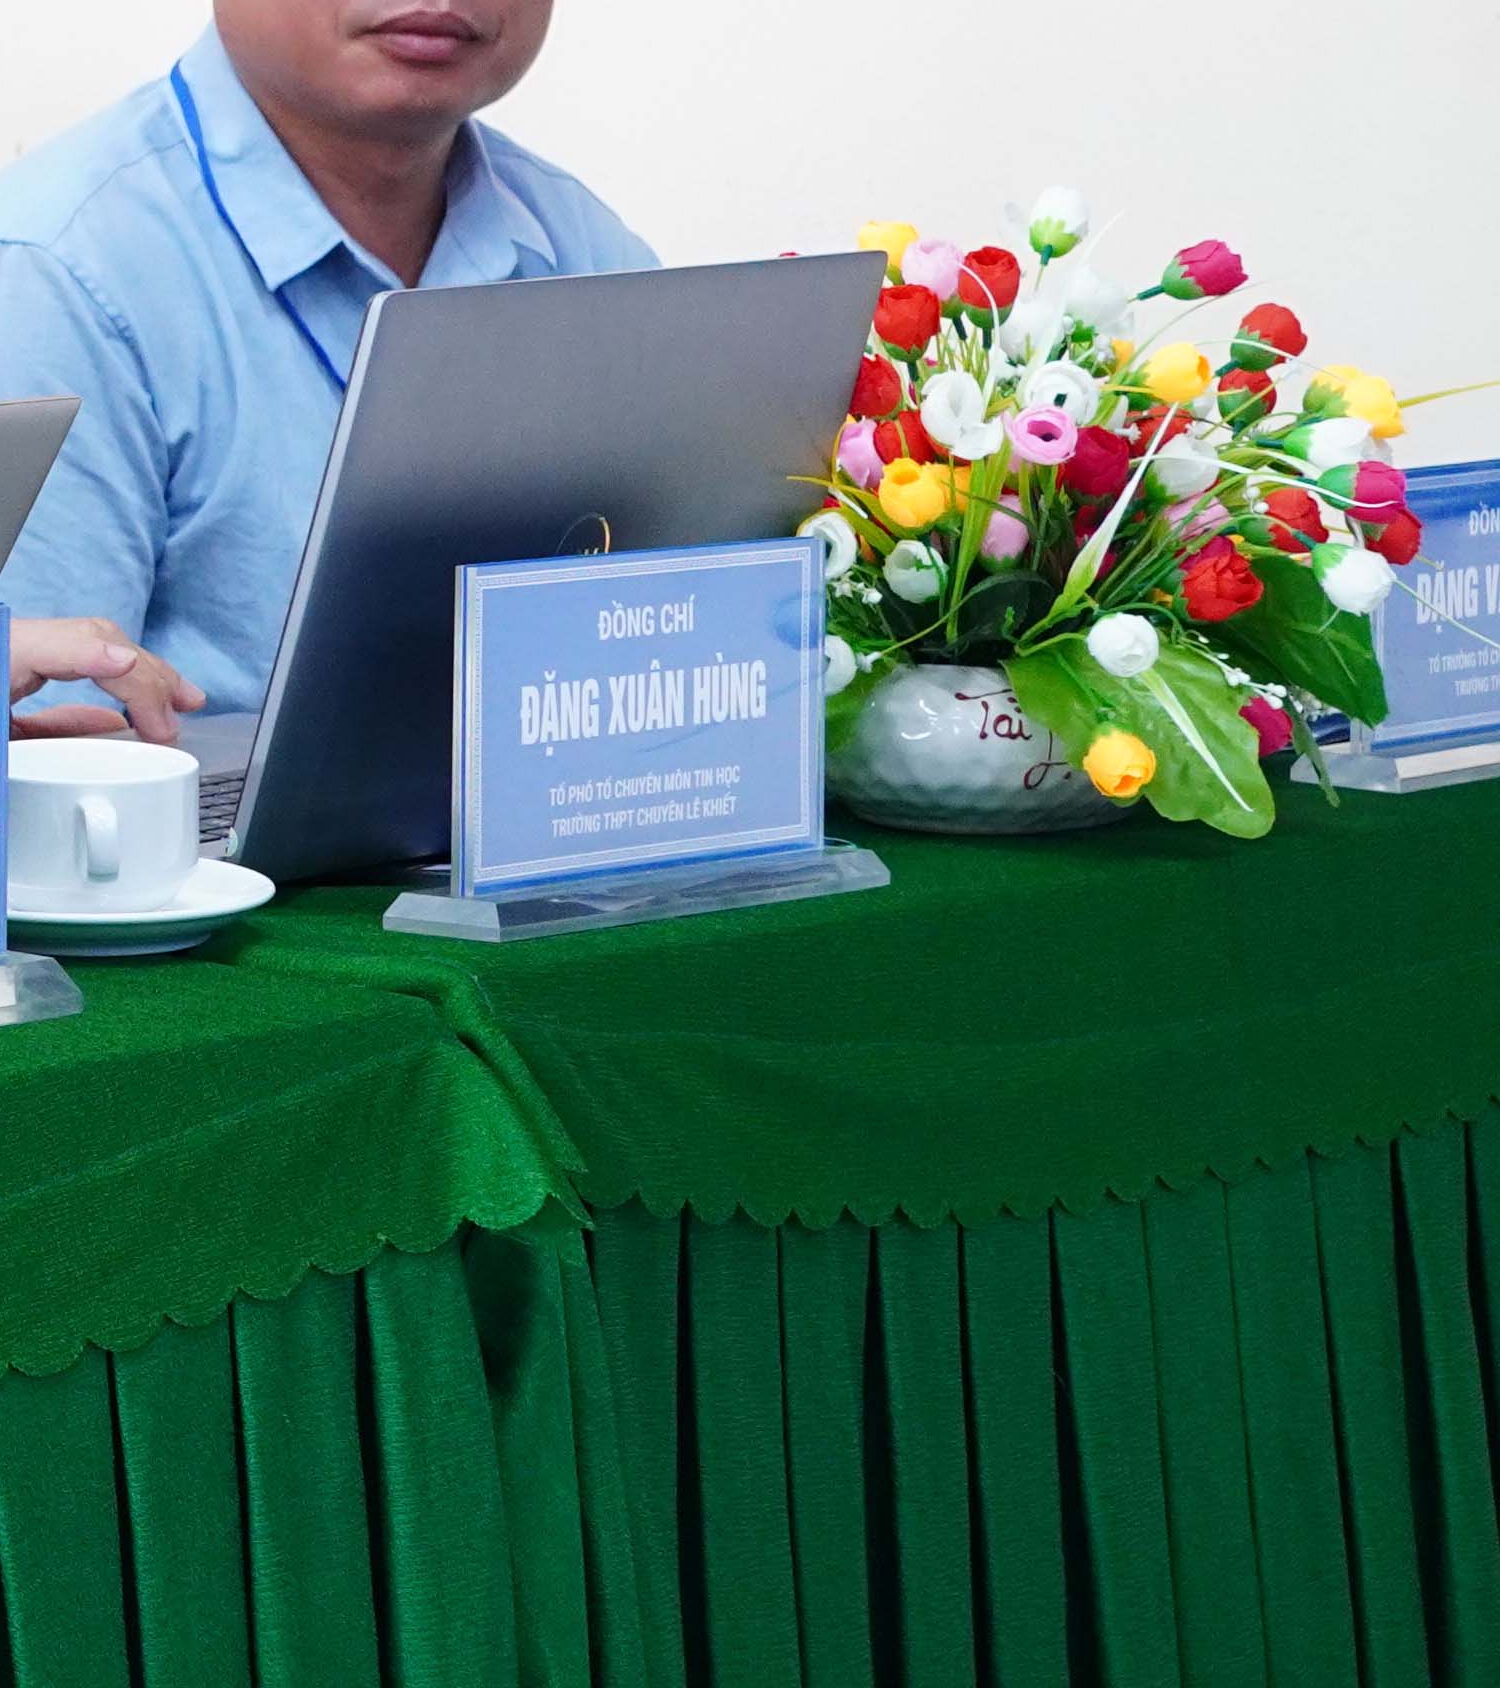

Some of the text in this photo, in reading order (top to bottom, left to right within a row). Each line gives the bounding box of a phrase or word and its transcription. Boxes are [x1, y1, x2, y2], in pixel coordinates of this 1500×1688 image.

[1468, 500, 1500, 536] ĐỒN
[598, 594, 694, 641] ĐỒNG CHÍ
[1416, 559, 1500, 634] ĐẶNG V
[520, 652, 766, 756] ĐẶNG XUÂN HÙNG
